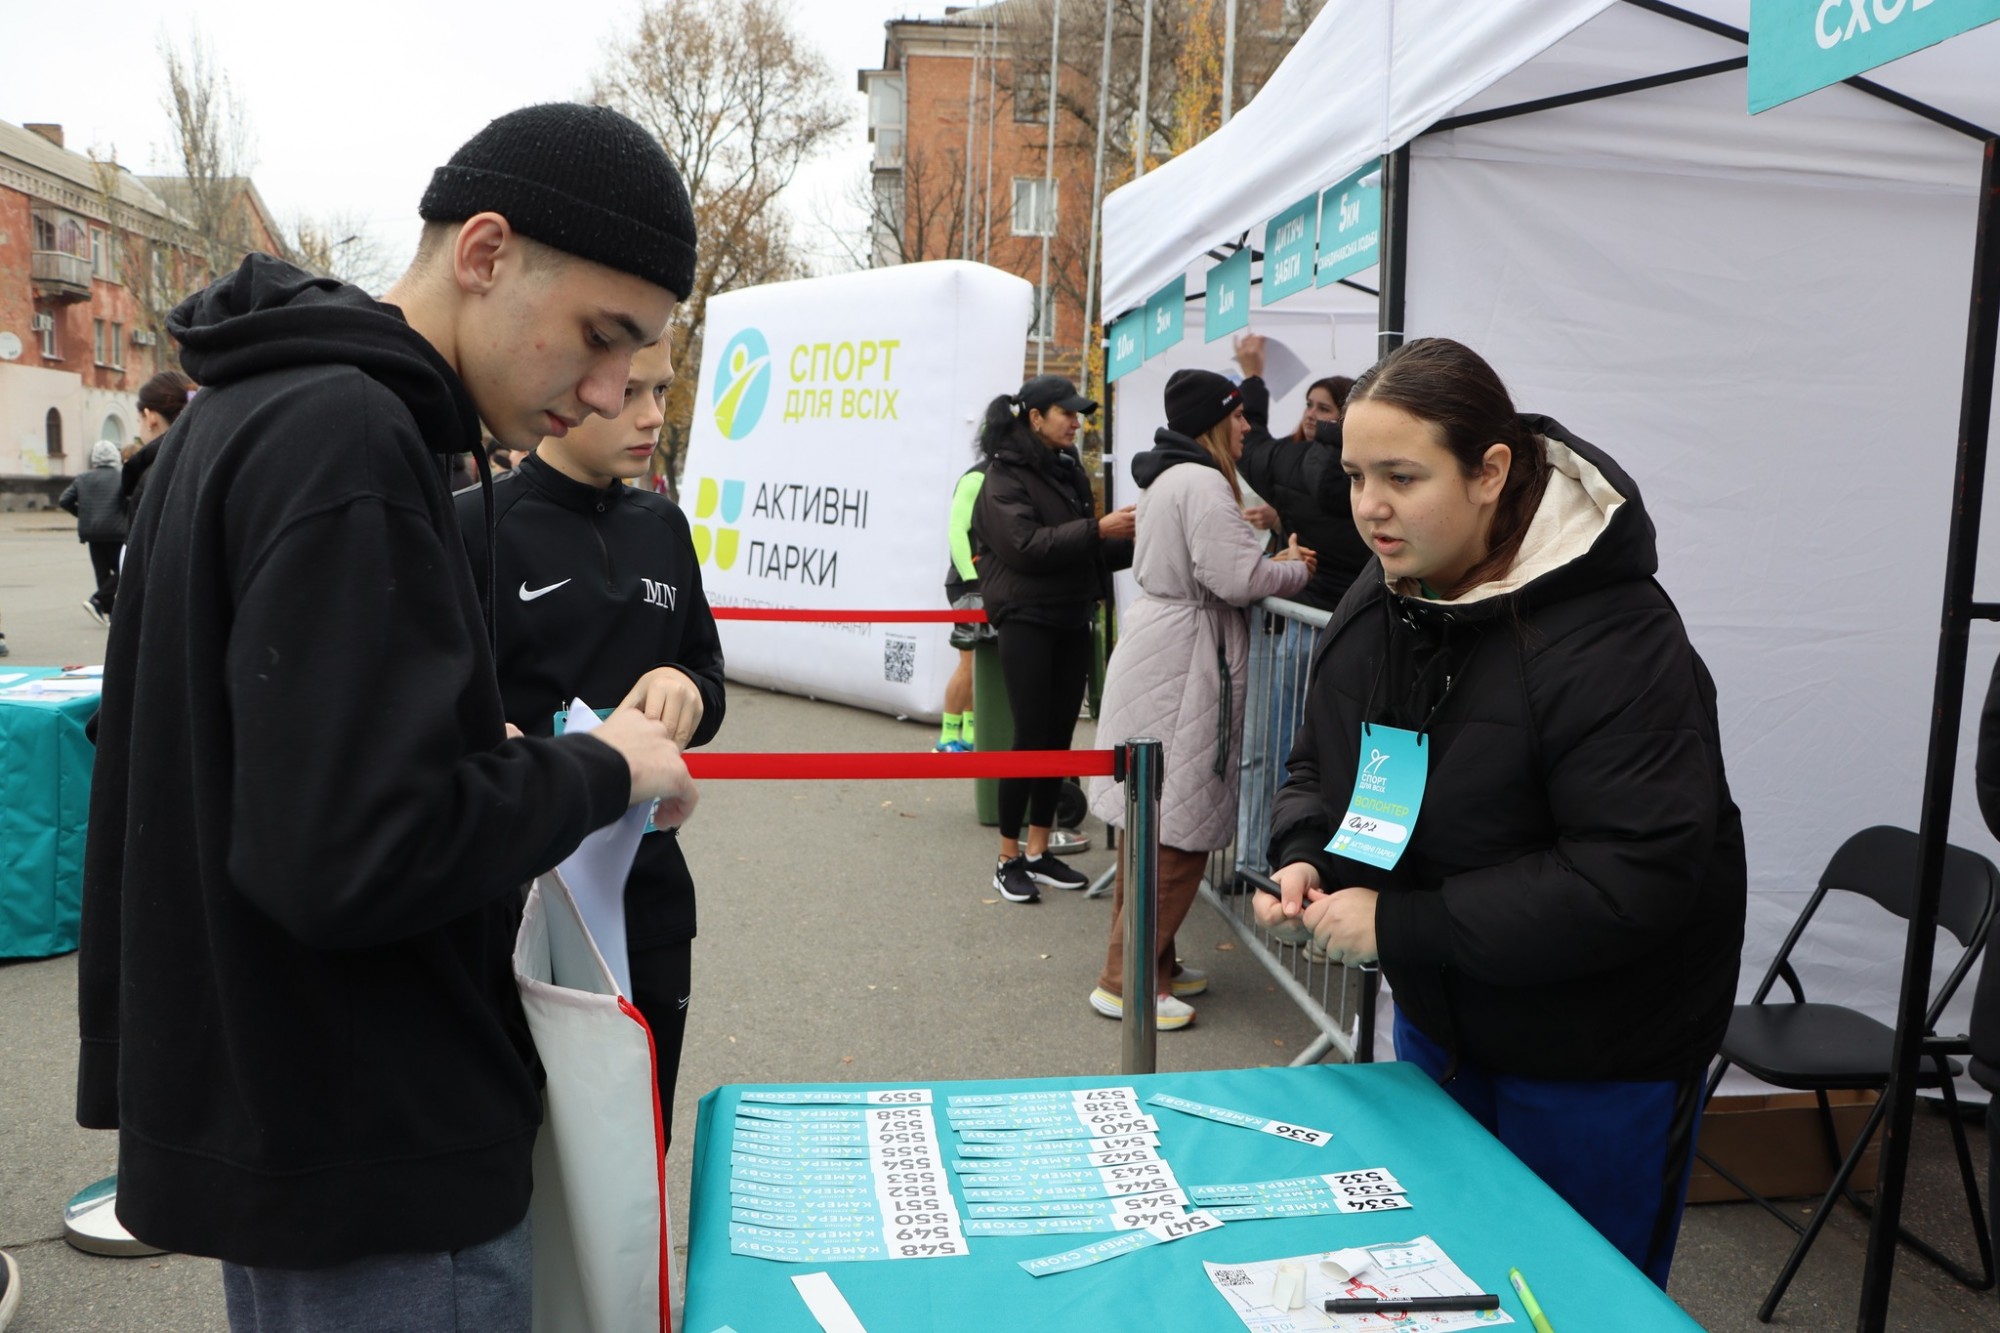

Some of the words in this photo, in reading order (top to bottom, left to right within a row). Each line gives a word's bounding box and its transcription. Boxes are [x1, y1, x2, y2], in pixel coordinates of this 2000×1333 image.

[1815, 0, 1937, 49] СХО
[1274, 253, 1301, 286] ЗАБІГИ
[790, 339, 901, 383] СПОРТ
[783, 389, 833, 424] ДЛЯ
[840, 388, 899, 420] ВСІХ
[752, 482, 869, 529] АКТИВНІ
[747, 540, 838, 589] ПАРКИ
[640, 578, 677, 612] MN
[1361, 773, 1387, 786] СПОРТ
[1359, 781, 1372, 790] ДЛЯ
[1372, 783, 1386, 793] ВСІХ
[1354, 795, 1410, 817] ВОЛОНТЕР
[879, 1092, 921, 1102] 559
[954, 1096, 1005, 1104] СХОВУ
[1086, 1091, 1125, 1100] 537
[952, 1108, 1004, 1116] СХОВУ
[1010, 1104, 1067, 1112] КАМЕРА
[1084, 1101, 1128, 1112] 538
[743, 1108, 792, 1117] СХОВУ
[877, 1109, 920, 1119] 558
[1209, 1108, 1263, 1124] КАМЕРА
[741, 1120, 792, 1129] СХОВУ
[880, 1120, 923, 1131] 557
[957, 1119, 1006, 1127] СХОВУ
[1014, 1116, 1072, 1125] КАМЕРА
[1025, 1127, 1084, 1137] КАМЕРА
[1101, 1120, 1148, 1134] 540
[741, 1132, 792, 1141] СХОВУ
[880, 1132, 925, 1143] 556
[967, 1131, 1017, 1139] СХОВУ
[1276, 1126, 1319, 1142] 536
[740, 1142, 792, 1154] СХОВУ
[1024, 1142, 1082, 1151] КАМЕРА
[1103, 1137, 1146, 1149] 541
[882, 1146, 928, 1157] 555
[964, 1145, 1015, 1153] СХОВУ
[738, 1157, 791, 1167] СХОВУ
[1021, 1156, 1082, 1165] КАМЕРА
[1101, 1150, 1147, 1163] 542
[882, 1158, 930, 1170] 554
[961, 1160, 1012, 1168] СХОВУ
[742, 1170, 794, 1180] СХОВУ
[1030, 1171, 1093, 1179] КАМЕРА
[1112, 1165, 1160, 1178] 543
[887, 1172, 935, 1184] 553
[968, 1174, 1021, 1182] СХОВУ
[1256, 1178, 1318, 1188] КАМЕРА
[1334, 1172, 1382, 1185] 532
[738, 1183, 793, 1193] СХОВУ
[1116, 1178, 1168, 1191] 544
[1198, 1184, 1248, 1194] СХОВУ
[1344, 1184, 1393, 1196] 533
[888, 1185, 936, 1197] 552
[971, 1189, 1025, 1197] СХОВУ
[1033, 1186, 1098, 1195] КАМЕРА
[739, 1197, 796, 1208] СХОВУ
[895, 1199, 940, 1211] 551
[1041, 1202, 1105, 1210] КАМЕРА
[1125, 1194, 1177, 1210] 545
[1264, 1202, 1329, 1212] КАМЕРА
[1348, 1198, 1399, 1210] 534
[977, 1205, 1031, 1213] СХОВУ
[1212, 1206, 1257, 1217] СХОВ
[739, 1211, 797, 1222] СХОВУ
[895, 1213, 948, 1225] 550
[1124, 1212, 1175, 1225] 546
[971, 1221, 1029, 1229] СХОВУ
[1036, 1218, 1104, 1227] КАМЕРА
[1165, 1217, 1210, 1237] 547
[737, 1227, 795, 1237] СХОВУ
[896, 1227, 948, 1240] 549
[739, 1242, 798, 1254] СХОВУ
[900, 1242, 955, 1255] 548
[1085, 1233, 1146, 1254] КАМЕРА
[809, 1245, 879, 1254] КАМЕРА
[1030, 1253, 1080, 1270] СХОВУ
